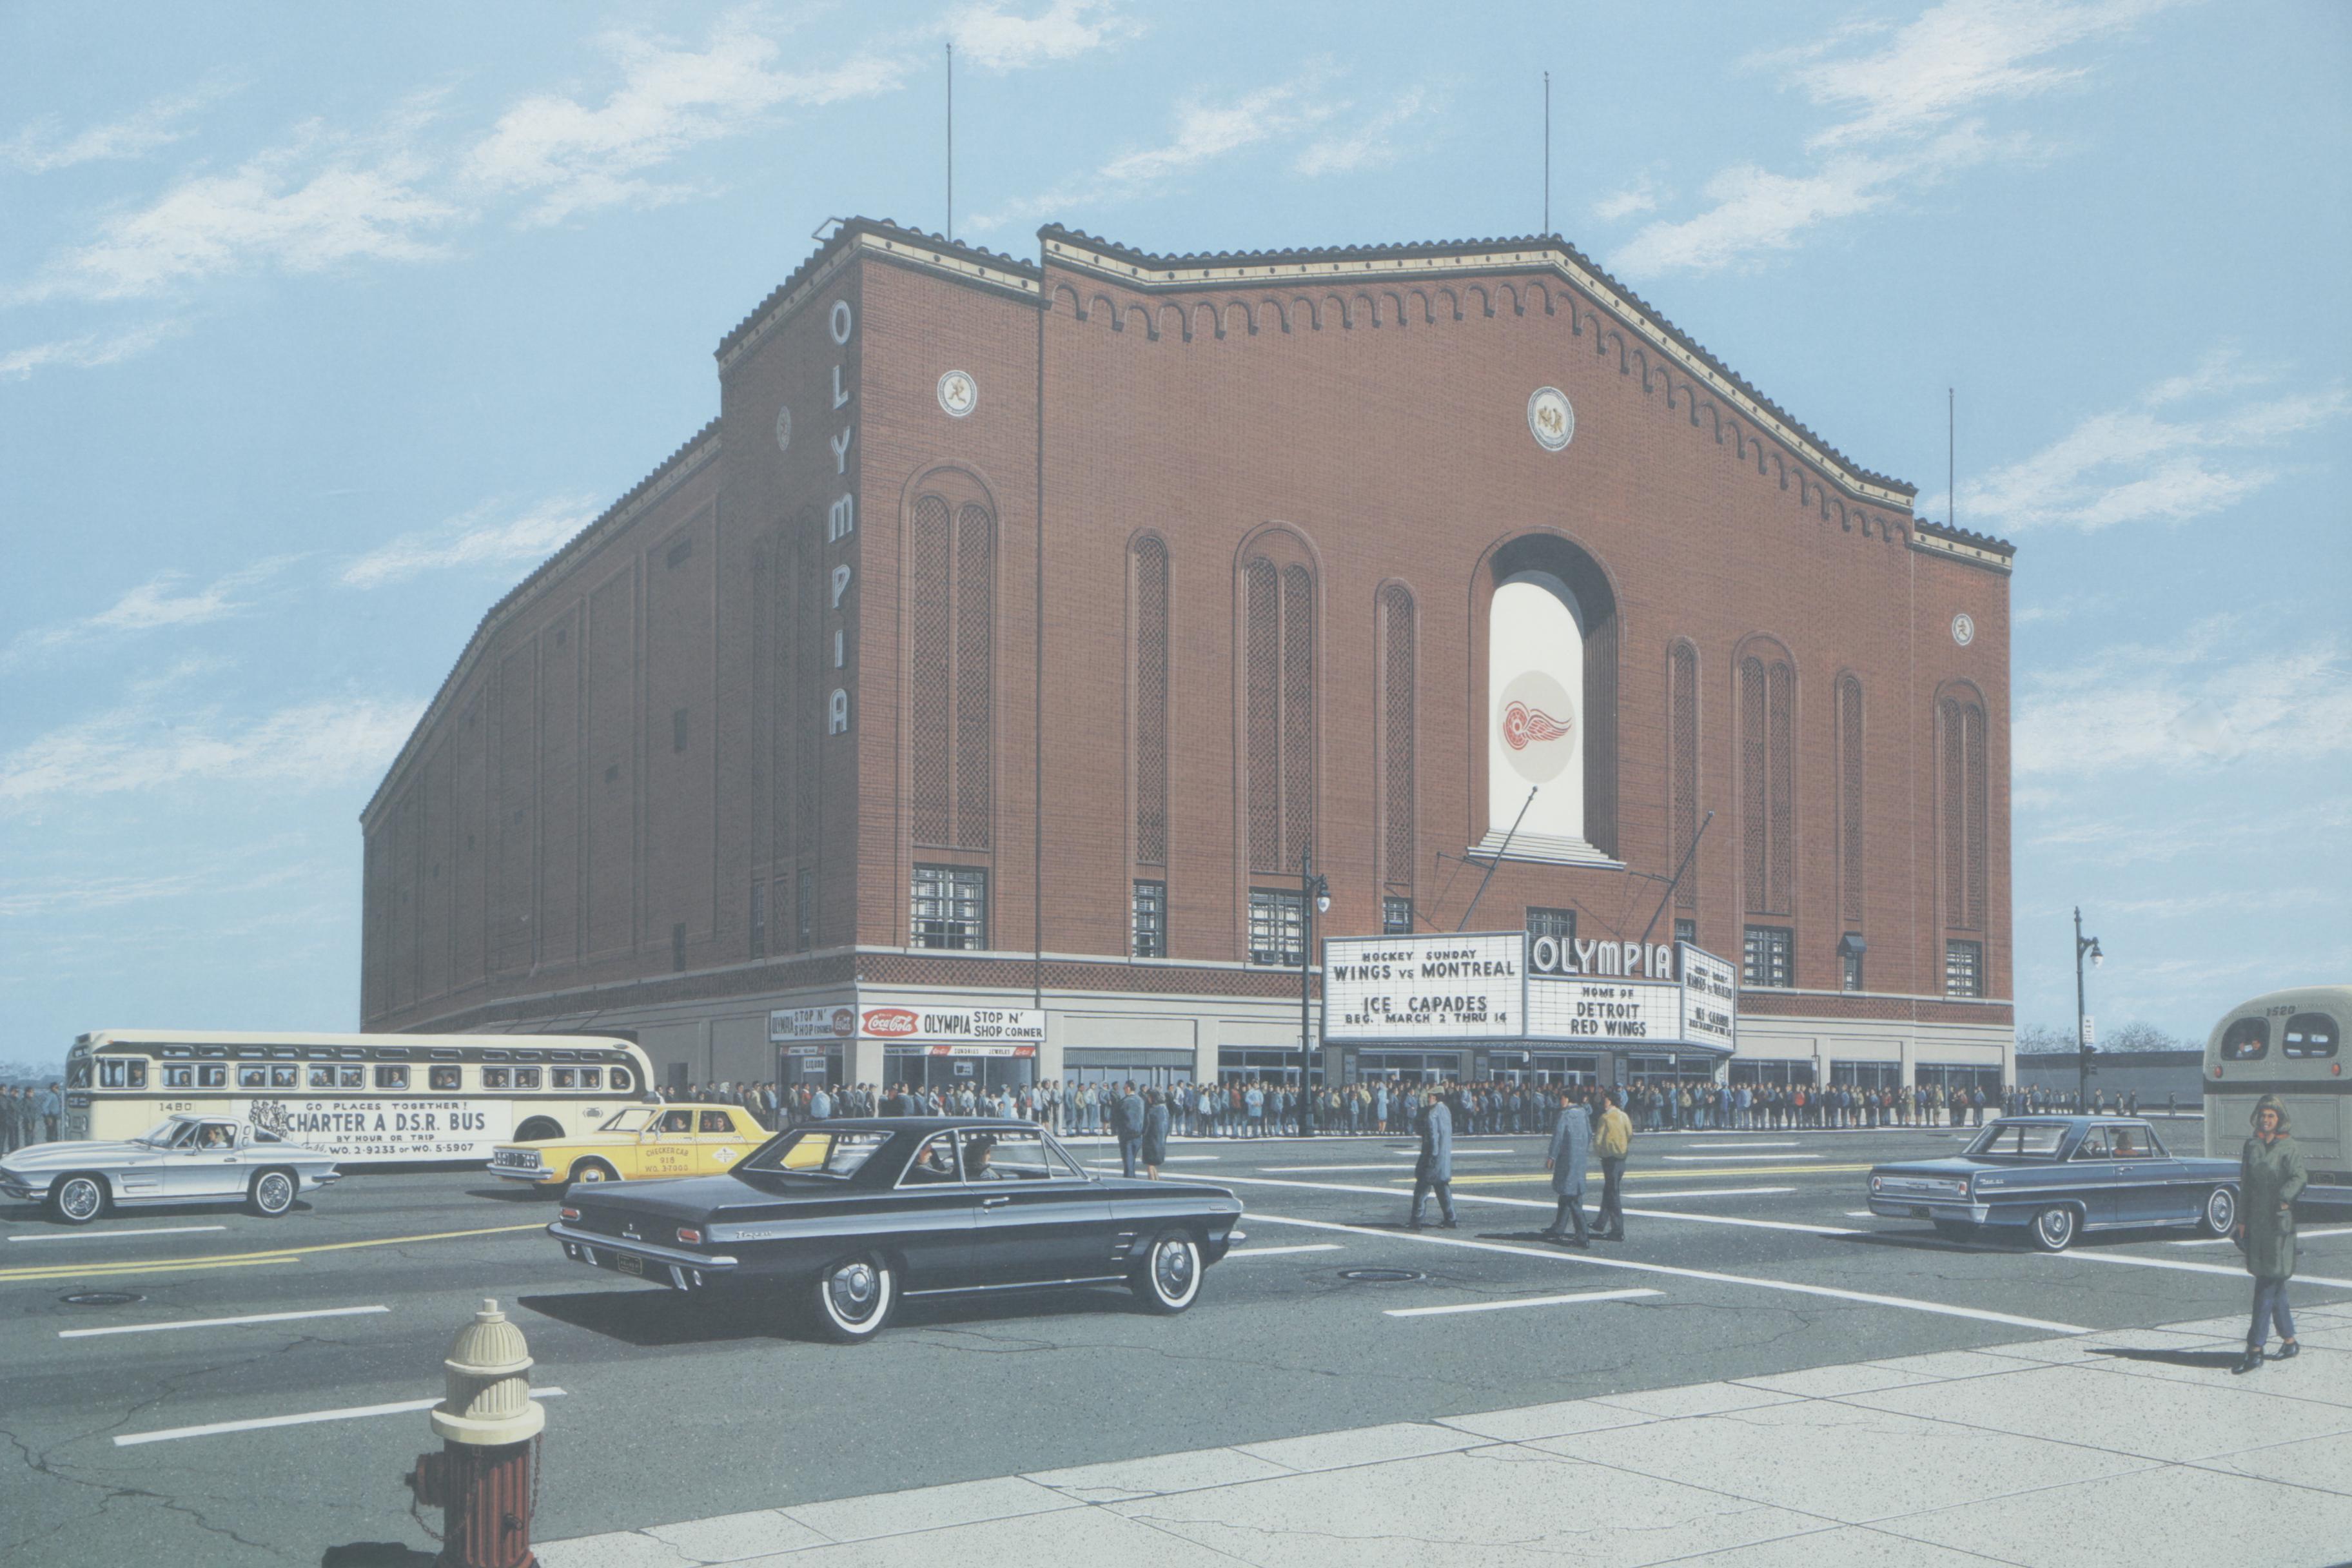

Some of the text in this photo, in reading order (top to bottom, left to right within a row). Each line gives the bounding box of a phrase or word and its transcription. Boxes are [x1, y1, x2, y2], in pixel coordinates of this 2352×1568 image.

[828, 299, 853, 736] OLYMPIA
[1362, 950, 1477, 962] HOCKEY SUNDAY
[1533, 936, 1672, 979] OLYMPIA
[1333, 965, 1391, 981] WINGS
[1421, 961, 1515, 978] MONTREAL
[1582, 986, 1614, 998] HOME
[1364, 995, 1487, 1014] ICE CAPADES
[1576, 1001, 1640, 1019] DETROIT
[794, 1010, 814, 1022] STOP
[2266, 1005, 2296, 1017] 1520
[974, 1011, 1023, 1024] STOP N'
[1346, 1012, 1507, 1024] BEG. MARCH 2 THRU 14
[794, 1024, 814, 1036] SHOP
[924, 1014, 971, 1034] OLYMPIA
[1571, 1018, 1647, 1037] RED WINGS
[974, 1025, 1043, 1037] SHOP CORNER
[160, 1102, 191, 1112] 1480
[286, 1112, 485, 1132] CHARTER A D.S.R. BUS
[355, 1146, 395, 1154] 2-9233
[436, 1143, 474, 1152] 5-5907
[646, 1147, 689, 1157] CHECKER CAB
